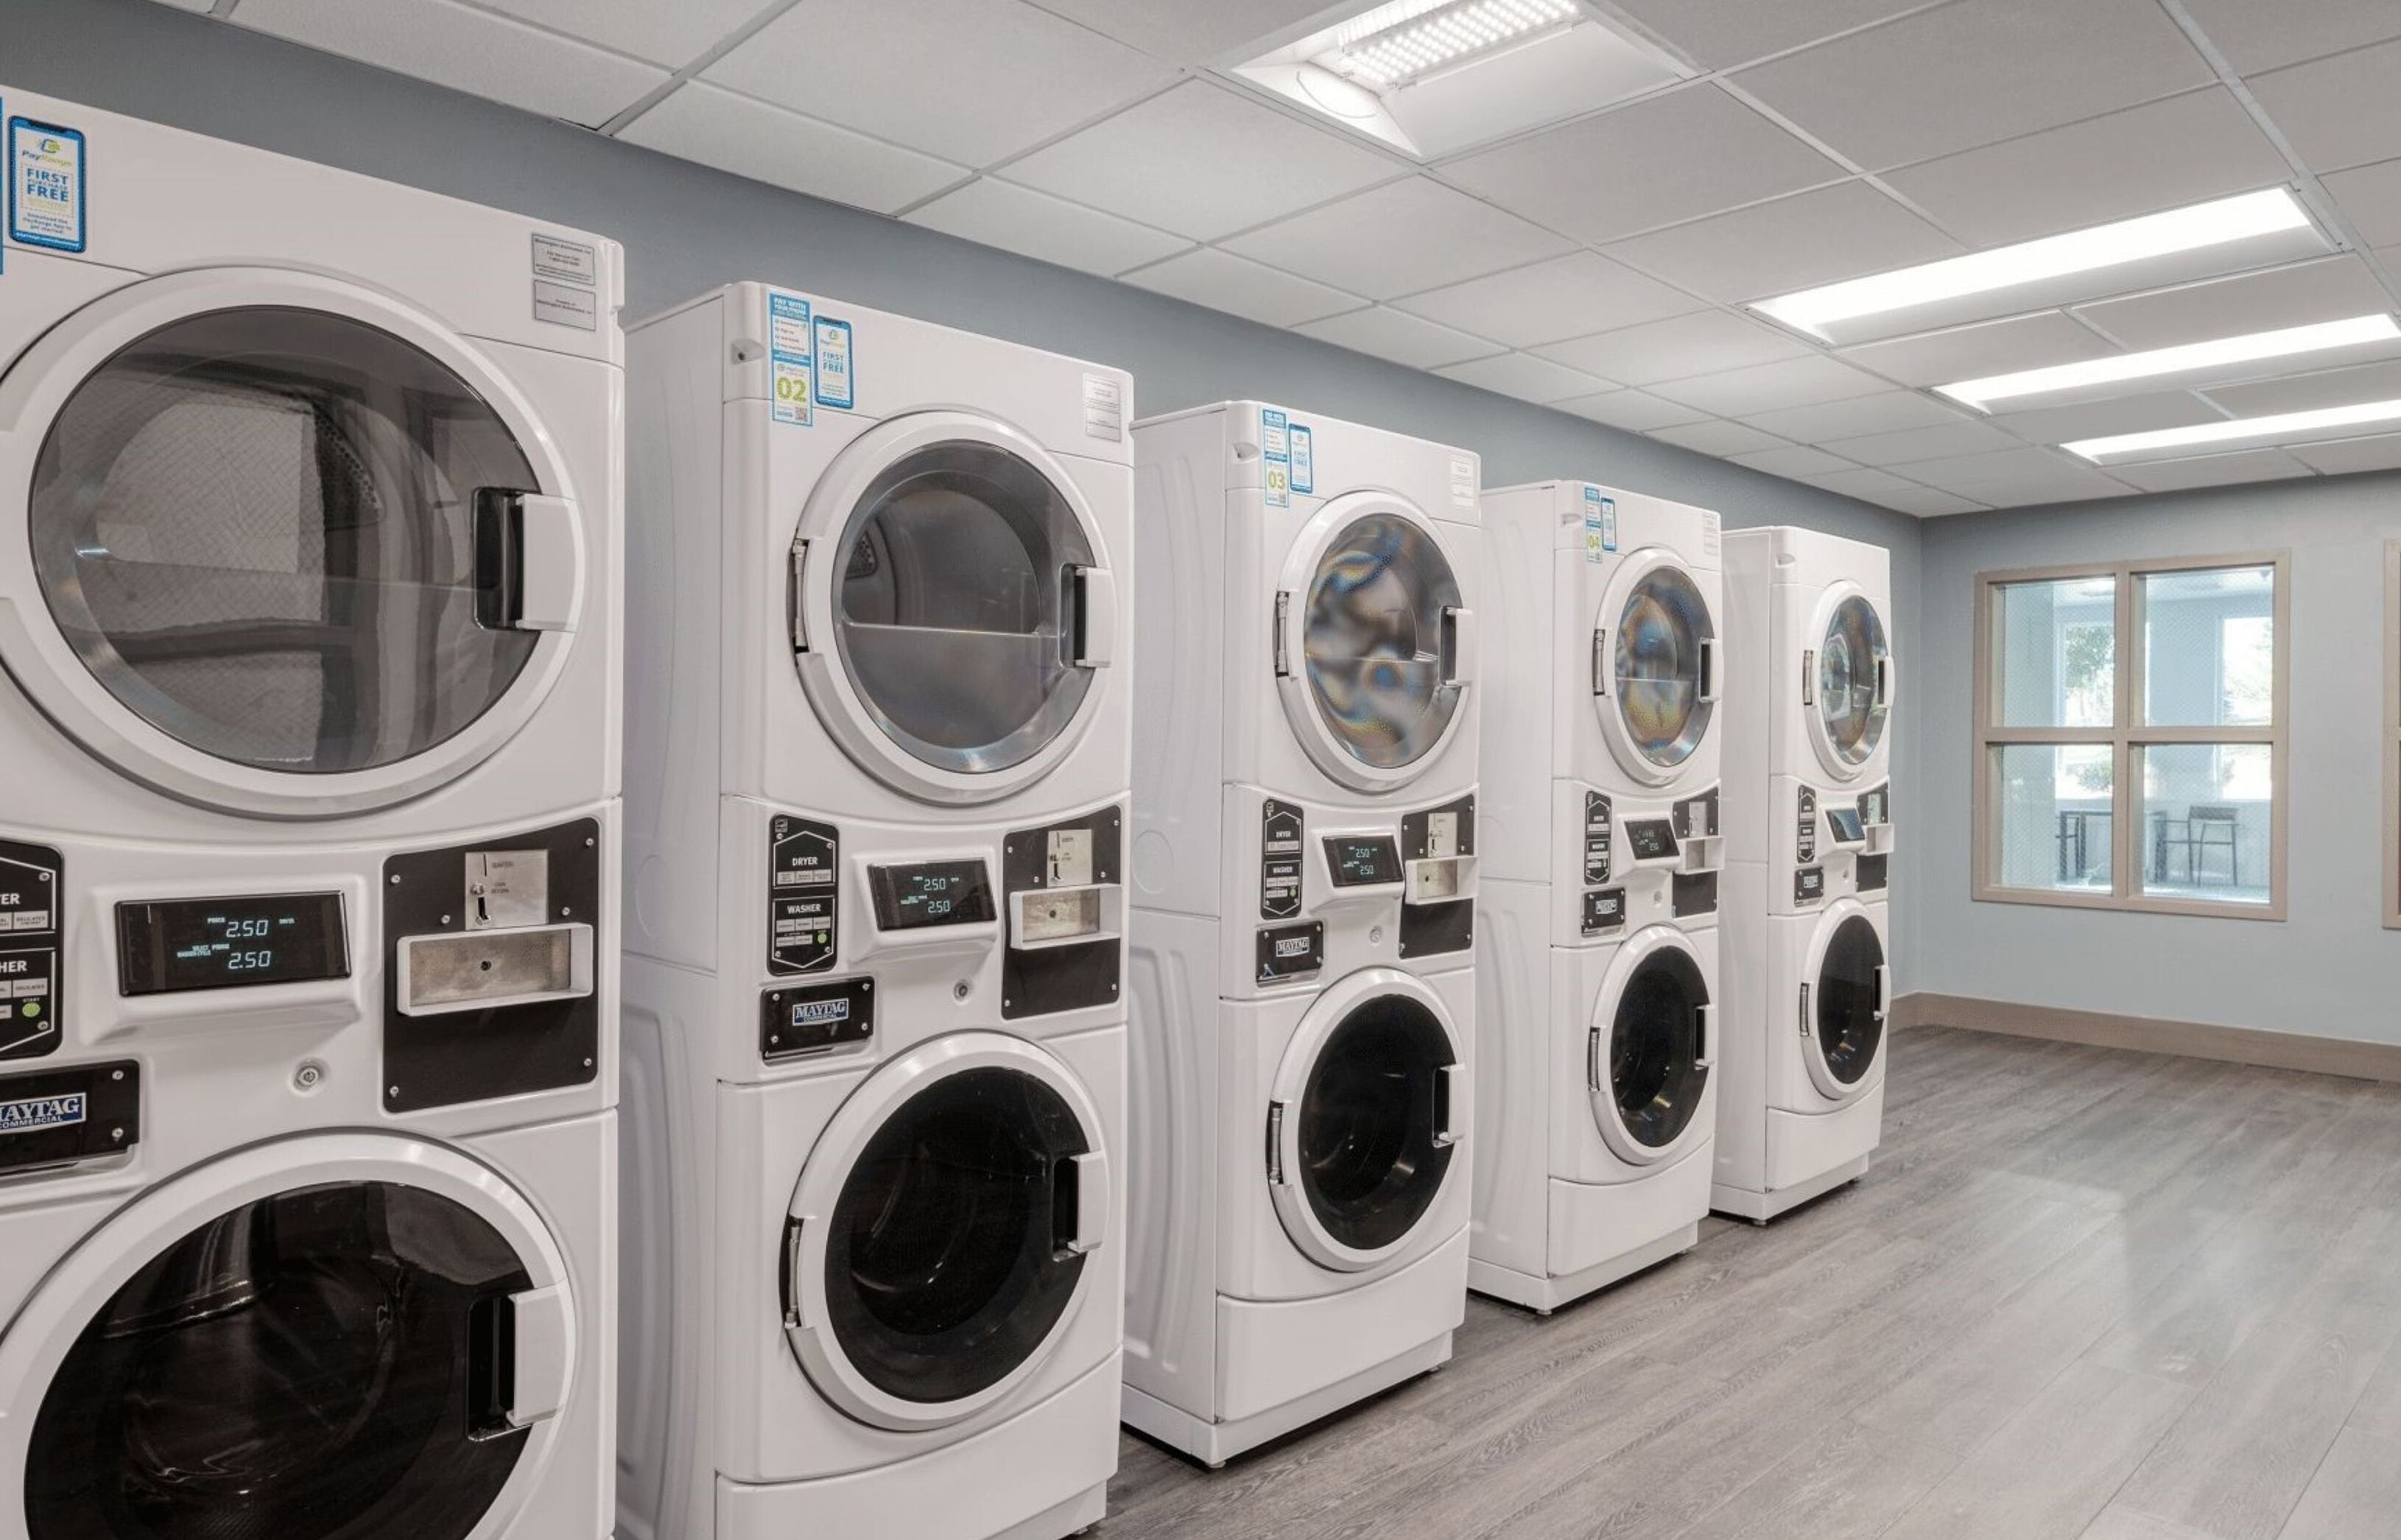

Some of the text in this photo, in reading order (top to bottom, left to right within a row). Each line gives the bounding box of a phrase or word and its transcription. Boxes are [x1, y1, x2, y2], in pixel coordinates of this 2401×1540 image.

[27, 168, 68, 185] FIRST
[27, 184, 68, 202] FREE
[823, 351, 844, 362] FIRST
[823, 362, 845, 374] FREE
[777, 377, 806, 402] 02
[1268, 471, 1286, 490] 03
[792, 857, 818, 866] DRYER
[0, 893, 21, 905] ER
[787, 904, 822, 914] WASHER
[226, 919, 269, 938] 2.50
[228, 951, 272, 970] 2.50
[795, 1002, 846, 1018] MAYTAG
